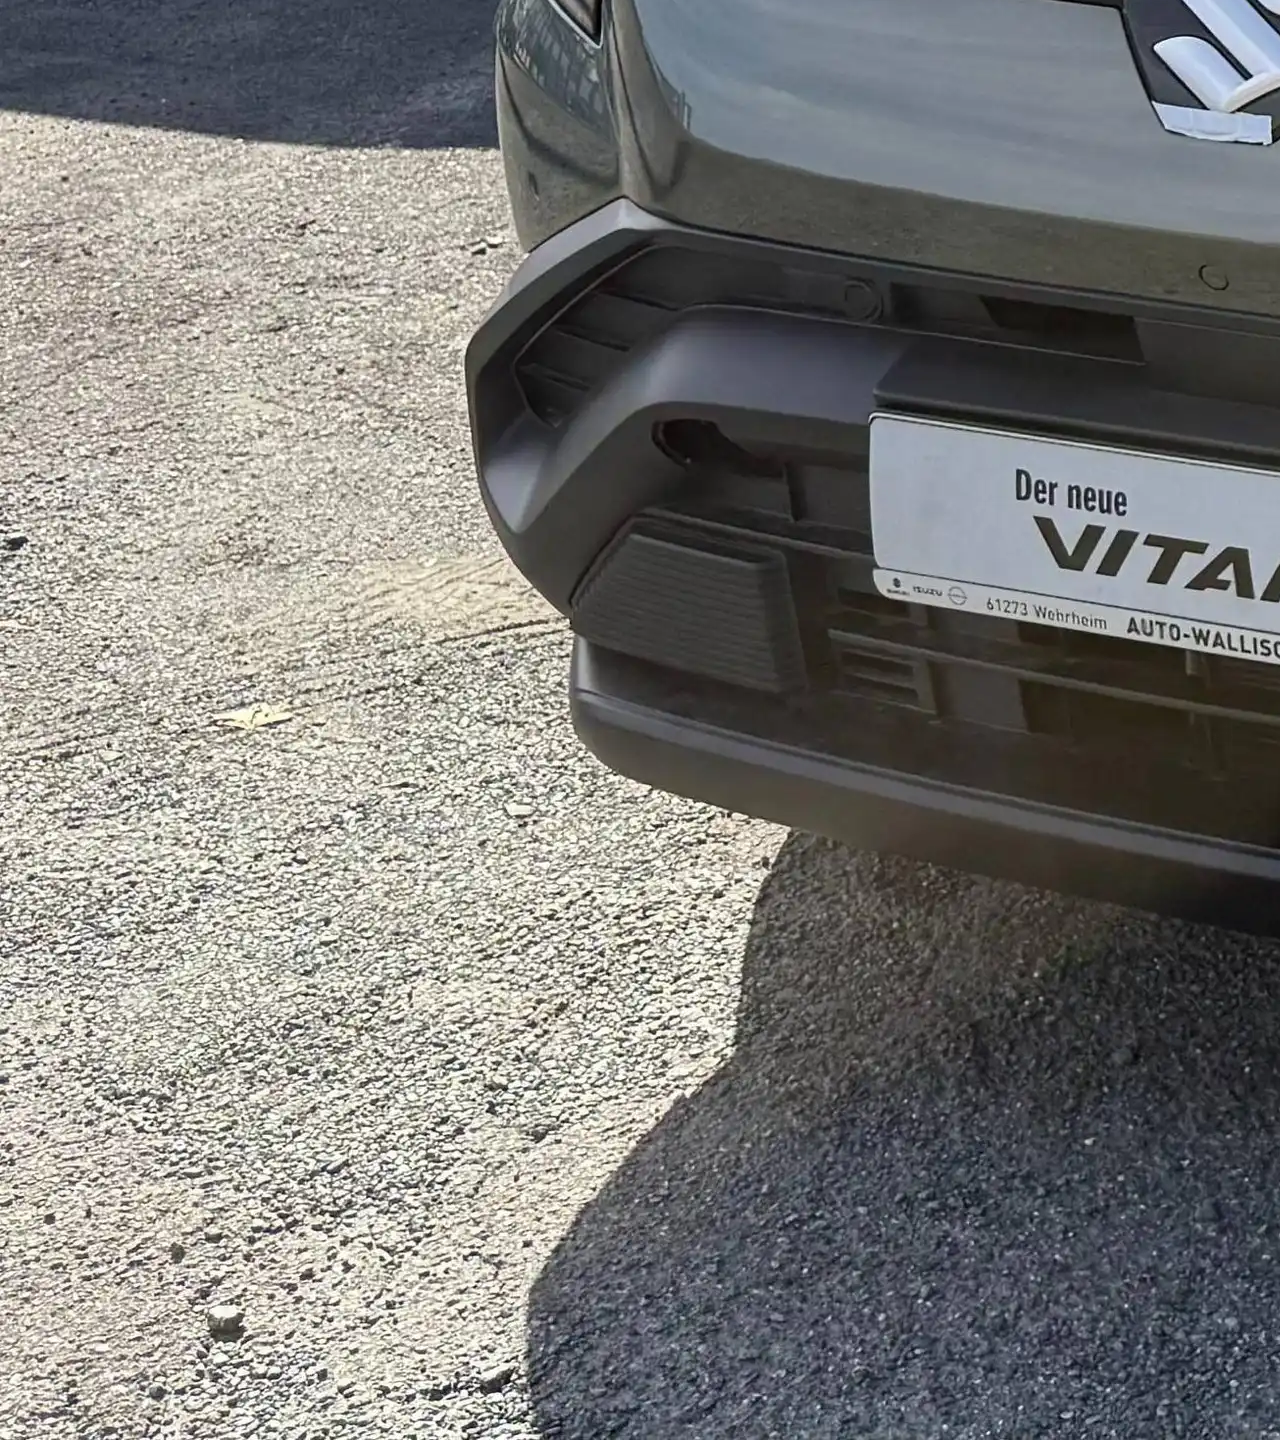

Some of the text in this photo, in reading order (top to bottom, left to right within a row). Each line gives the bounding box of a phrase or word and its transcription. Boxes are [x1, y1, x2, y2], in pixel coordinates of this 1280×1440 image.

[1015, 468, 1128, 517] Der neue
[985, 597, 1029, 617] 61273
